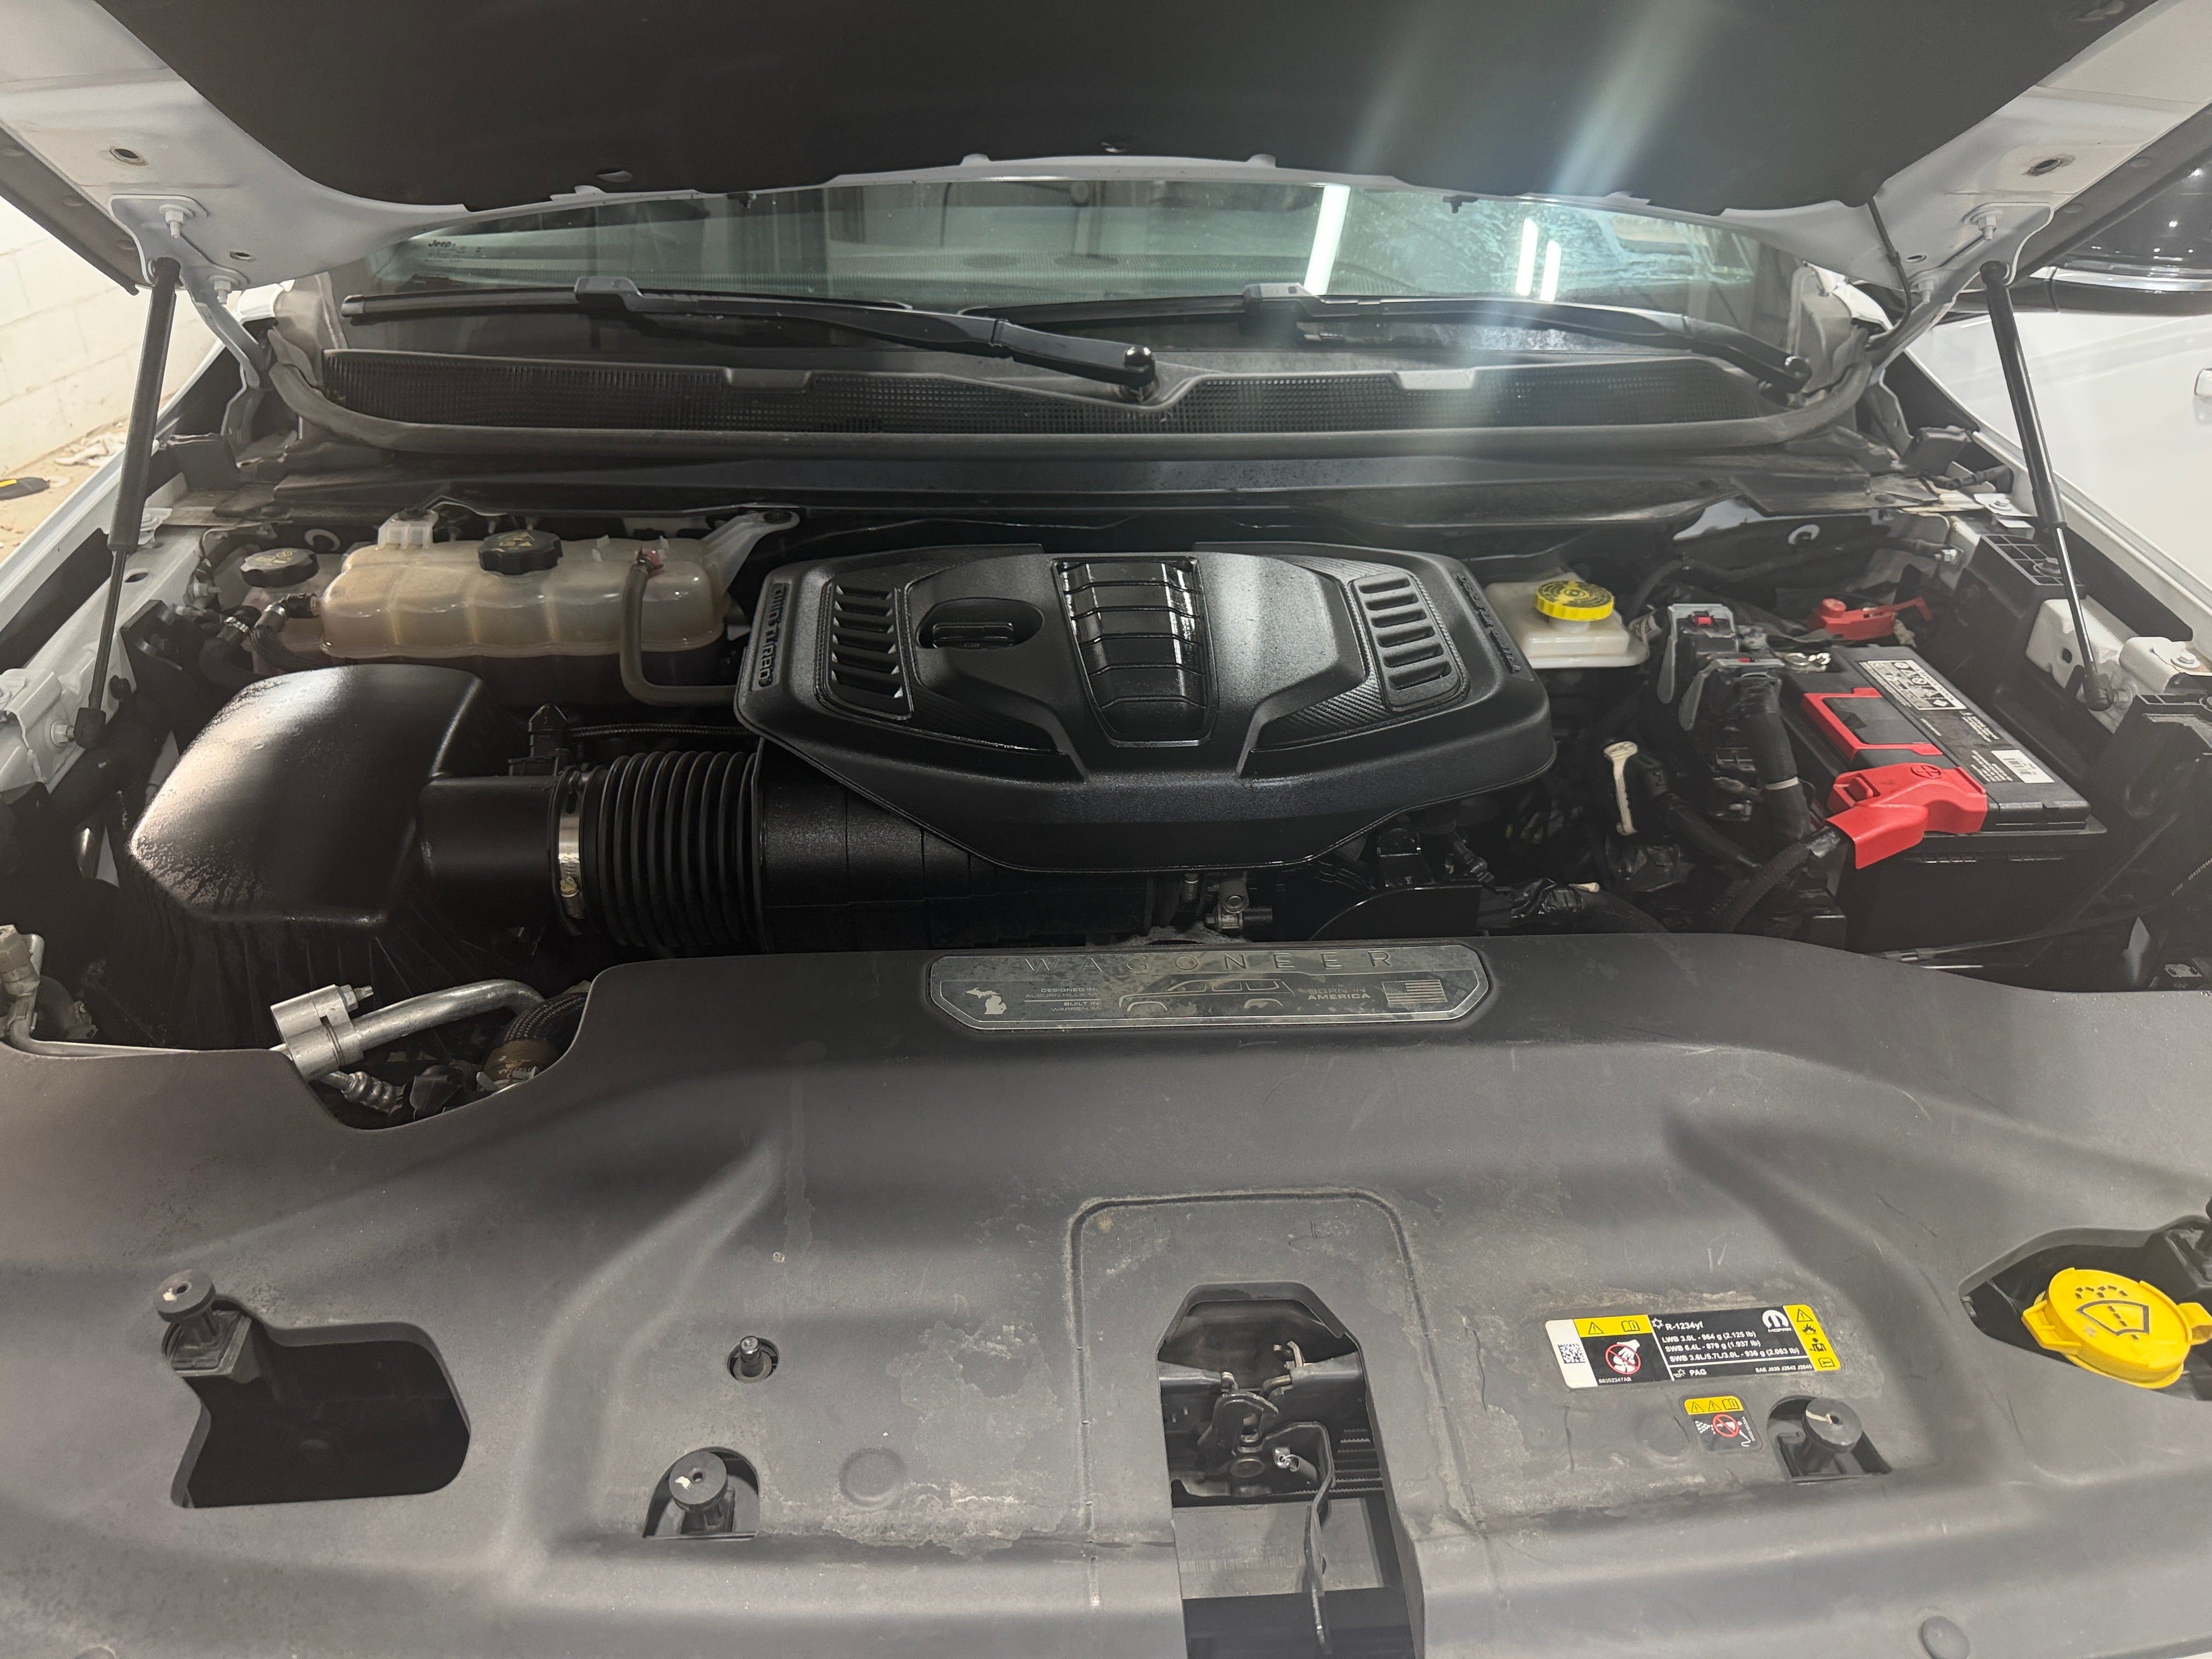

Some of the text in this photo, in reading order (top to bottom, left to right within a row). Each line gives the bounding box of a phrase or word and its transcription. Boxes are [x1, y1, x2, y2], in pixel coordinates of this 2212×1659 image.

[1024, 950, 1392, 974] WAGONEER
[1665, 1321, 1703, 1331] R-1234yf
[1680, 1334, 1697, 1342] 3.0L
[1723, 1331, 1745, 1340] (2.125
[1728, 1340, 1748, 1349] (1.937
[1689, 1350, 1740, 1361] 3.6L/5.7L/3.0L
[1766, 1348, 1788, 1357] (2.063
